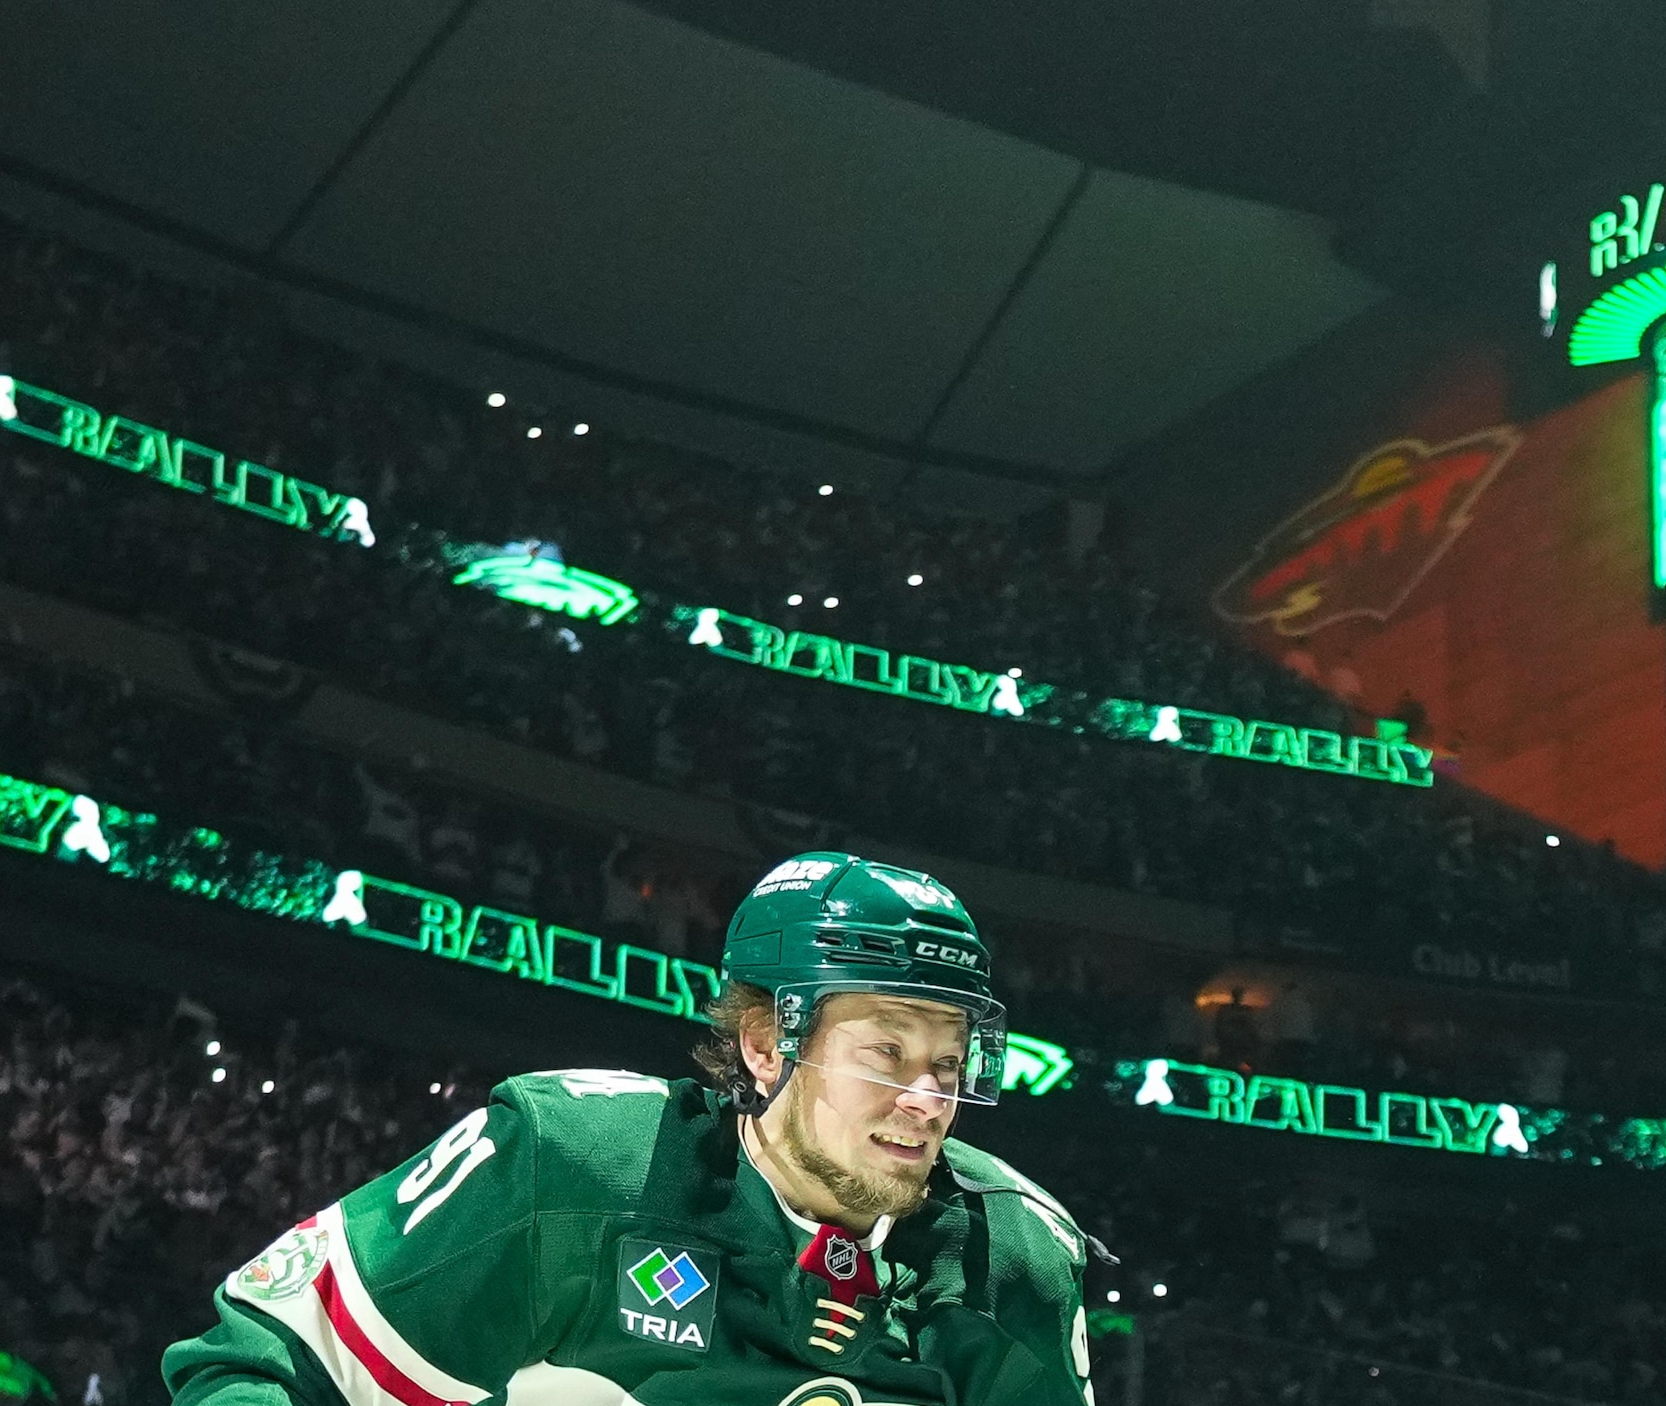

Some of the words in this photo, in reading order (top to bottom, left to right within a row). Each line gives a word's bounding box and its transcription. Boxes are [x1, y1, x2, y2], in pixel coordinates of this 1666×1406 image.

[716, 608, 1001, 713] RALLY
[915, 940, 979, 968] CCM
[1158, 1058, 1501, 1155] RALLY
[397, 1107, 497, 1236] 91
[832, 1251, 853, 1267] NHL
[620, 1308, 705, 1348] TRIA
